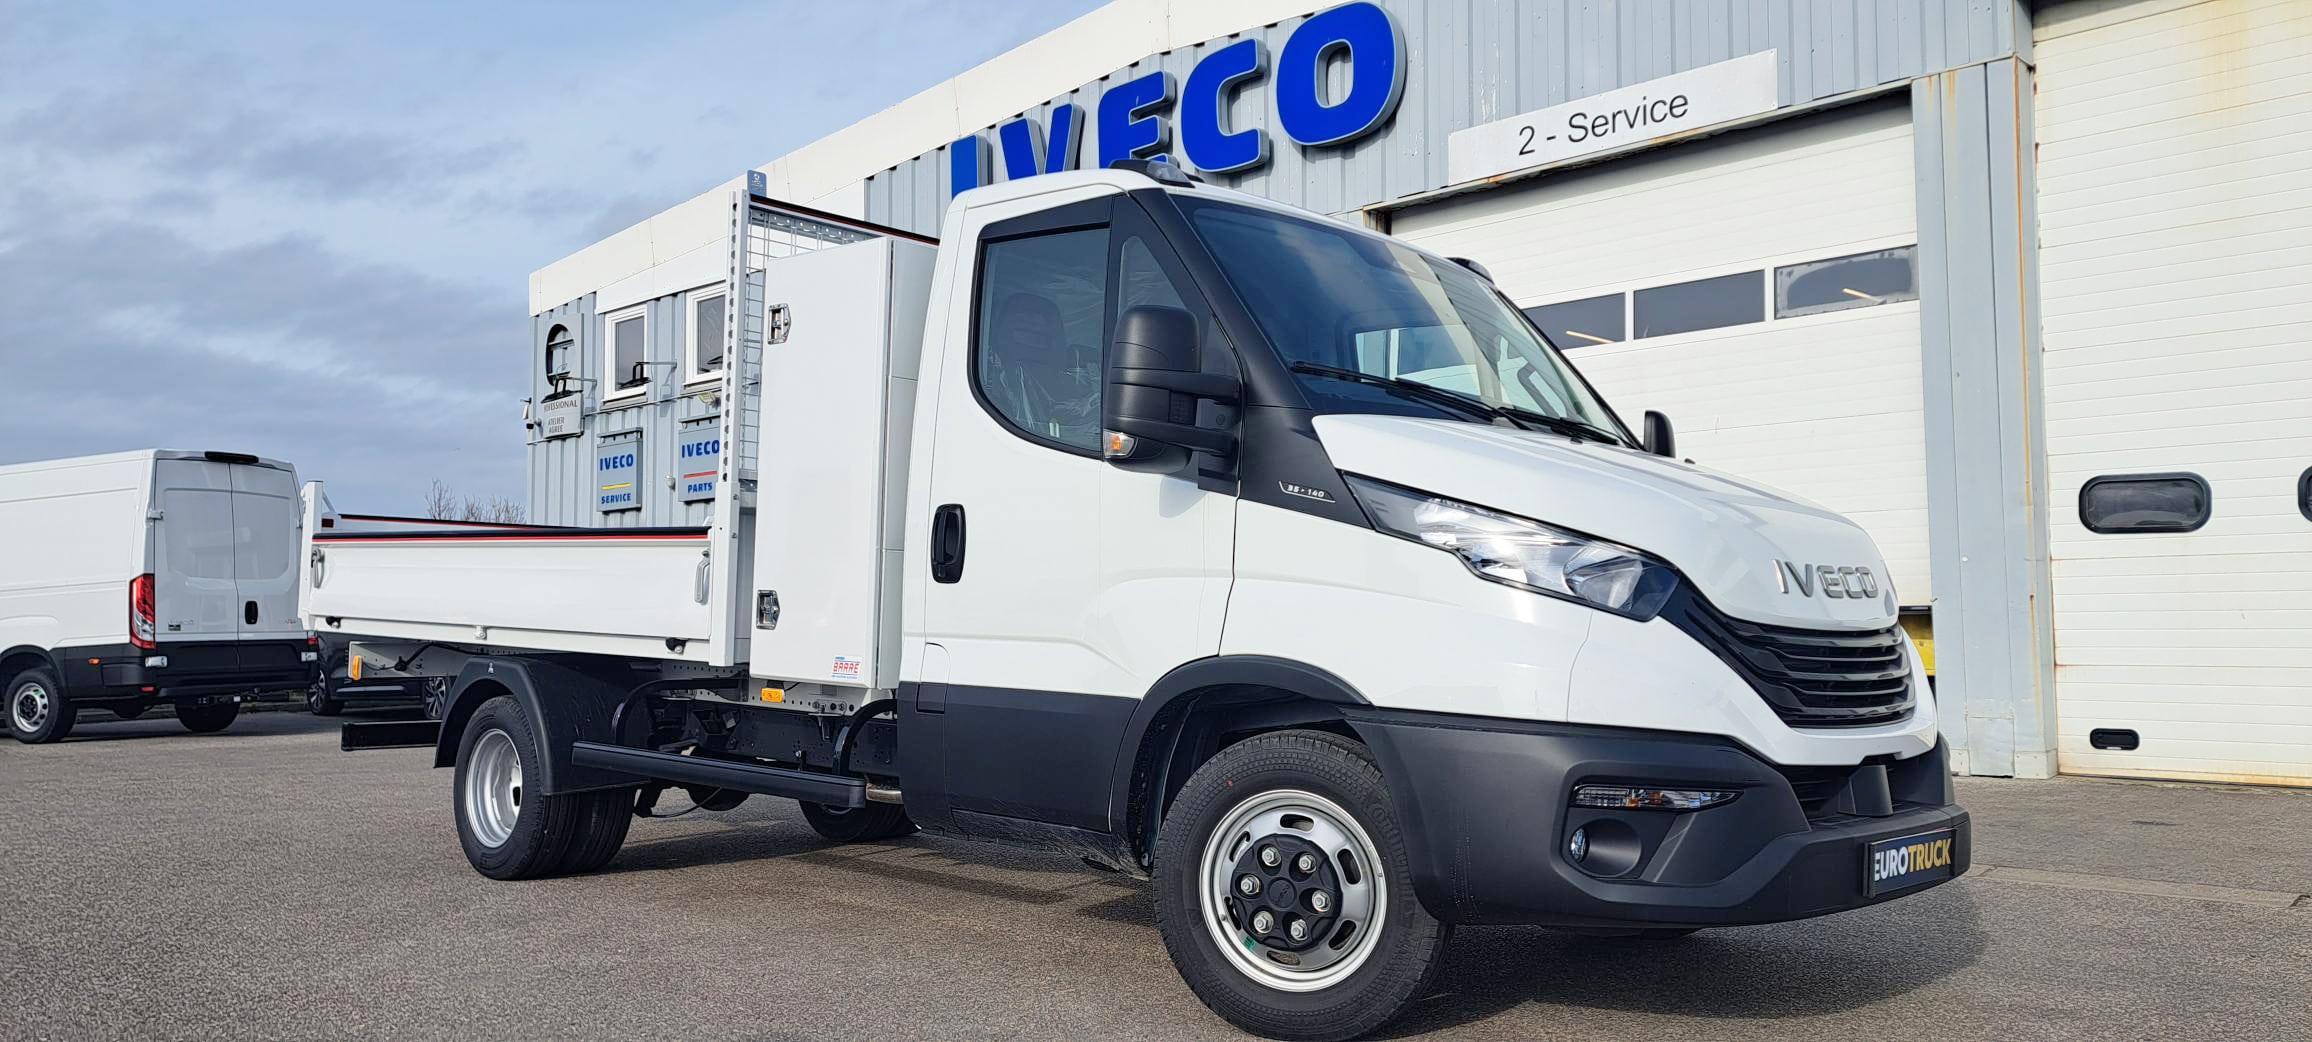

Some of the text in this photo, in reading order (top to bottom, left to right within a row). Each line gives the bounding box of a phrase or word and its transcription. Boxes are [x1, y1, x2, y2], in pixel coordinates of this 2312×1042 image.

[950, 1, 1404, 200] IVECO
[1518, 125, 1536, 156] 2
[1567, 94, 1689, 143] Service
[599, 453, 634, 471] IVECO
[681, 439, 720, 458] IVECO
[601, 492, 632, 505] SERVICE
[687, 481, 713, 493] PARTS
[1773, 559, 1879, 599] IVECO
[1874, 838, 1953, 881] EUROTRUCK
